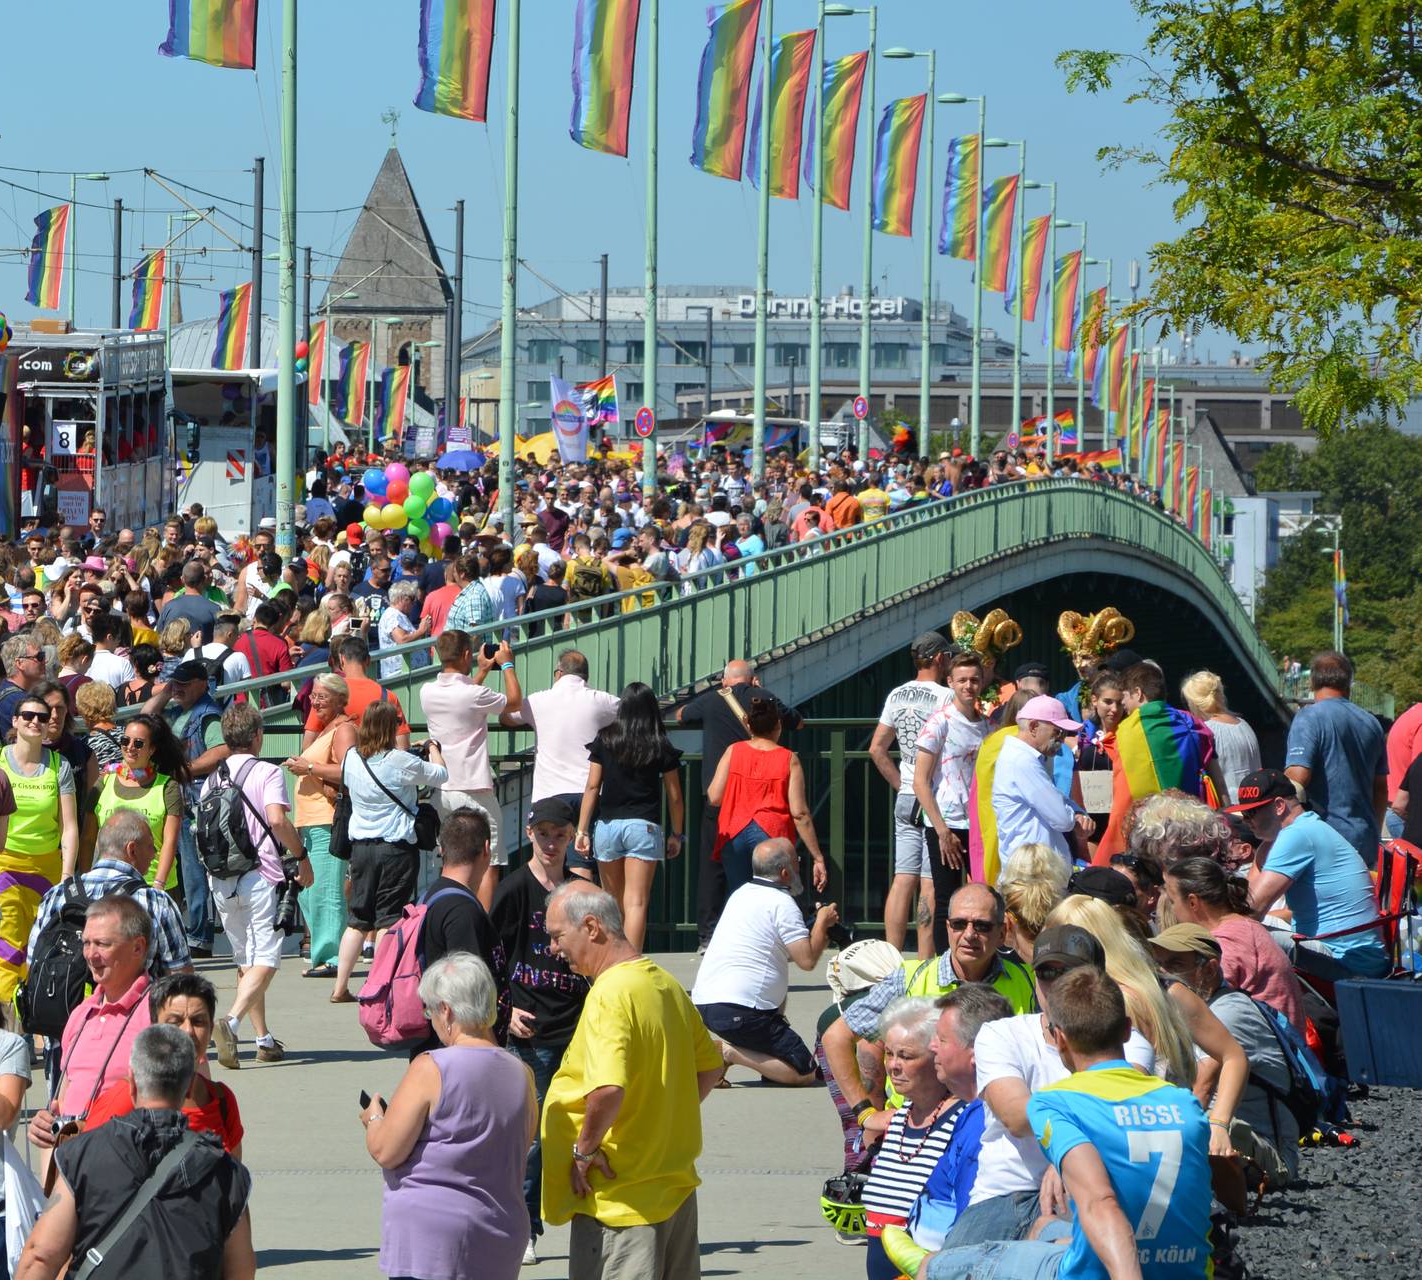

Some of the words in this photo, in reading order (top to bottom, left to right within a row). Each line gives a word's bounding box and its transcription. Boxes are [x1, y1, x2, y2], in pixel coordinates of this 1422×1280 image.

[59, 431, 70, 449] 8
[1113, 1103, 1186, 1127] RISSE
[1127, 1130, 1184, 1241] 7
[1155, 1245, 1197, 1264] KÖLN
